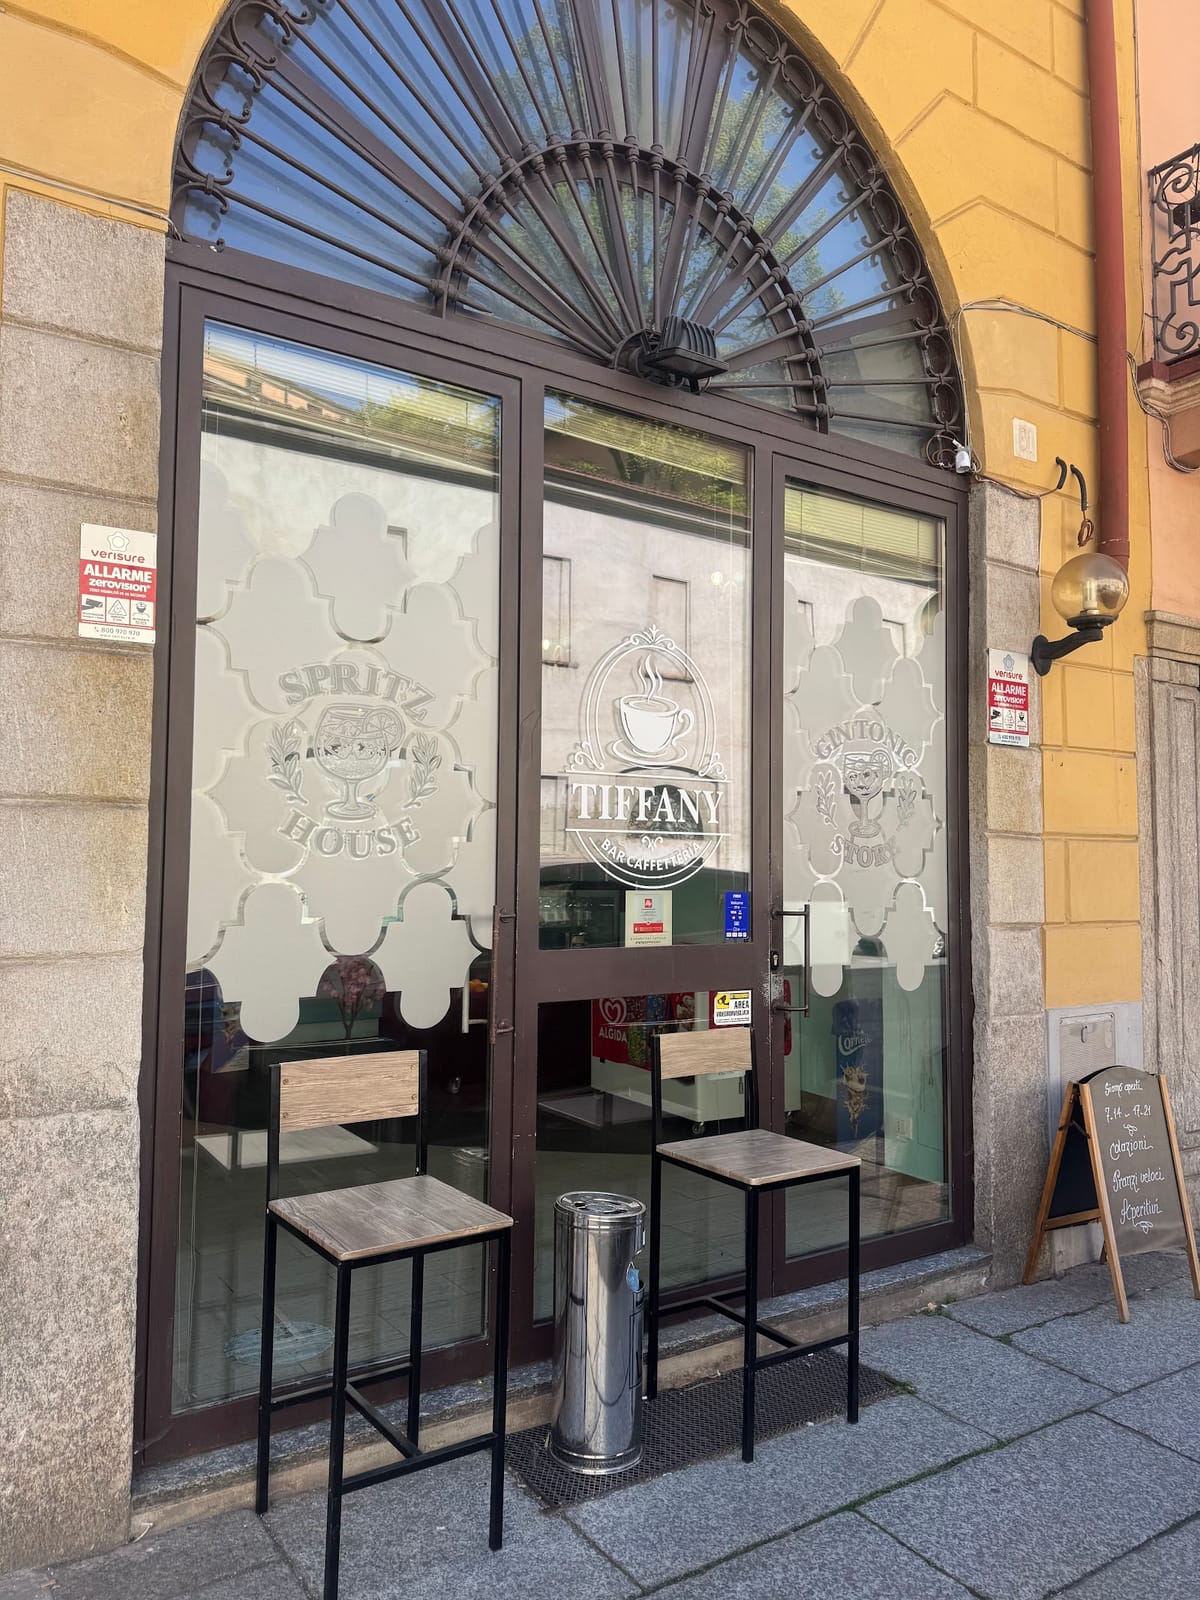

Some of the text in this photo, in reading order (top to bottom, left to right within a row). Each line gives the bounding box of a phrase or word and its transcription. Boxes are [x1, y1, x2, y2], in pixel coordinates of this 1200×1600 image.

[91, 549, 145, 563] verisure
[84, 563, 152, 583] ALLARME
[995, 669, 1023, 681] verisure
[279, 662, 436, 721] SPRITZ
[991, 682, 1026, 696] ALLARME
[572, 783, 724, 825] TIFFANY
[279, 810, 421, 859] HOUSE
[601, 838, 701, 871] BAR CAFFETTERIA
[733, 1000, 749, 1009] AREA
[599, 1026, 628, 1042] ALGIDA
[1110, 1136, 1154, 1160] Colazioni
[1113, 1168, 1165, 1193] Pranzi veloci
[1120, 1198, 1163, 1225] Aperitivi
